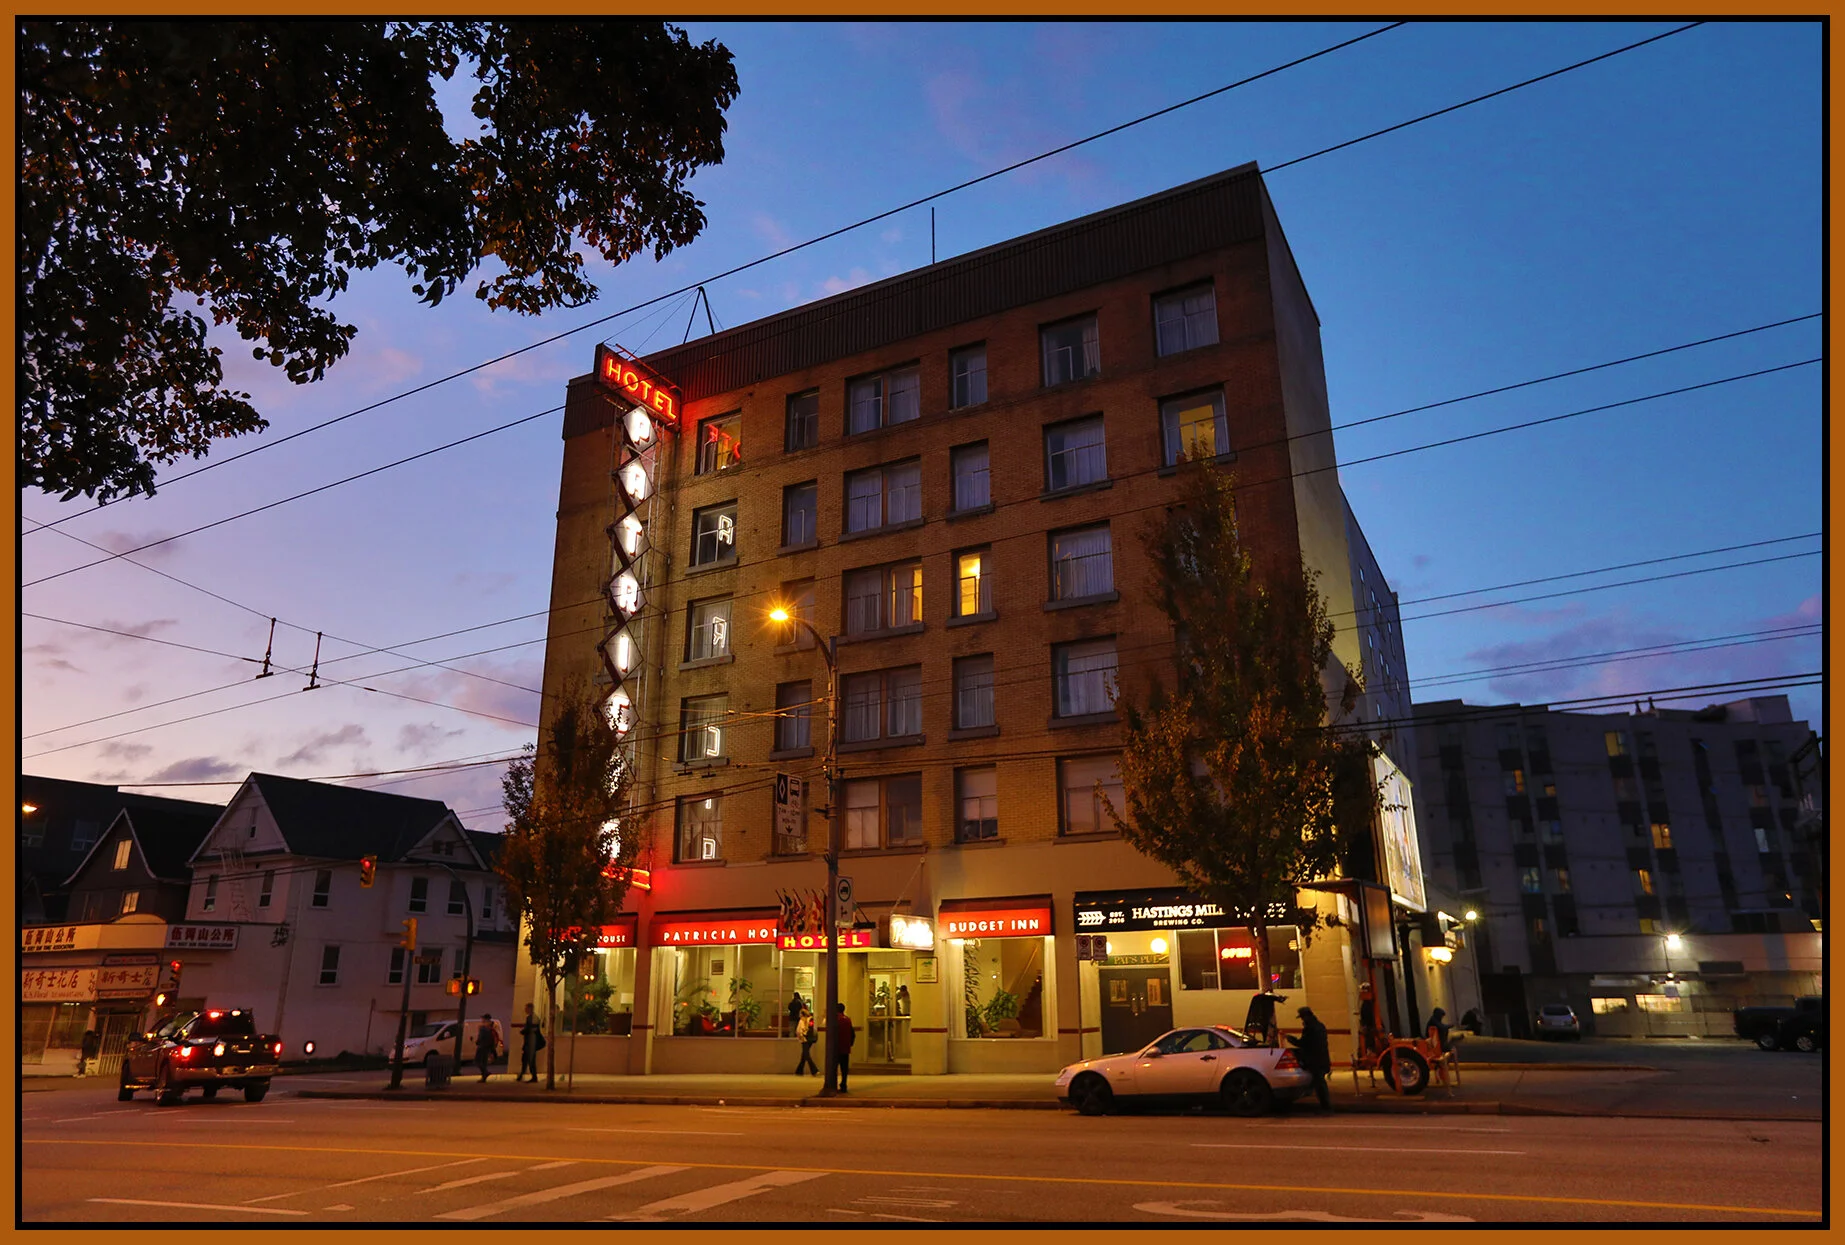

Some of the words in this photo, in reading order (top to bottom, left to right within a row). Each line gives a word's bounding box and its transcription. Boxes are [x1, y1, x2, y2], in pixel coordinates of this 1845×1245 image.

[606, 358, 677, 420] HOTEL
[1131, 905, 1193, 919] HASTINGS
[949, 920, 1004, 932] BUDGET
[1011, 919, 1039, 930] INN
[663, 930, 737, 941] PATRICIA
[783, 935, 863, 948] HOTEL
[1221, 947, 1252, 959] OPEN
